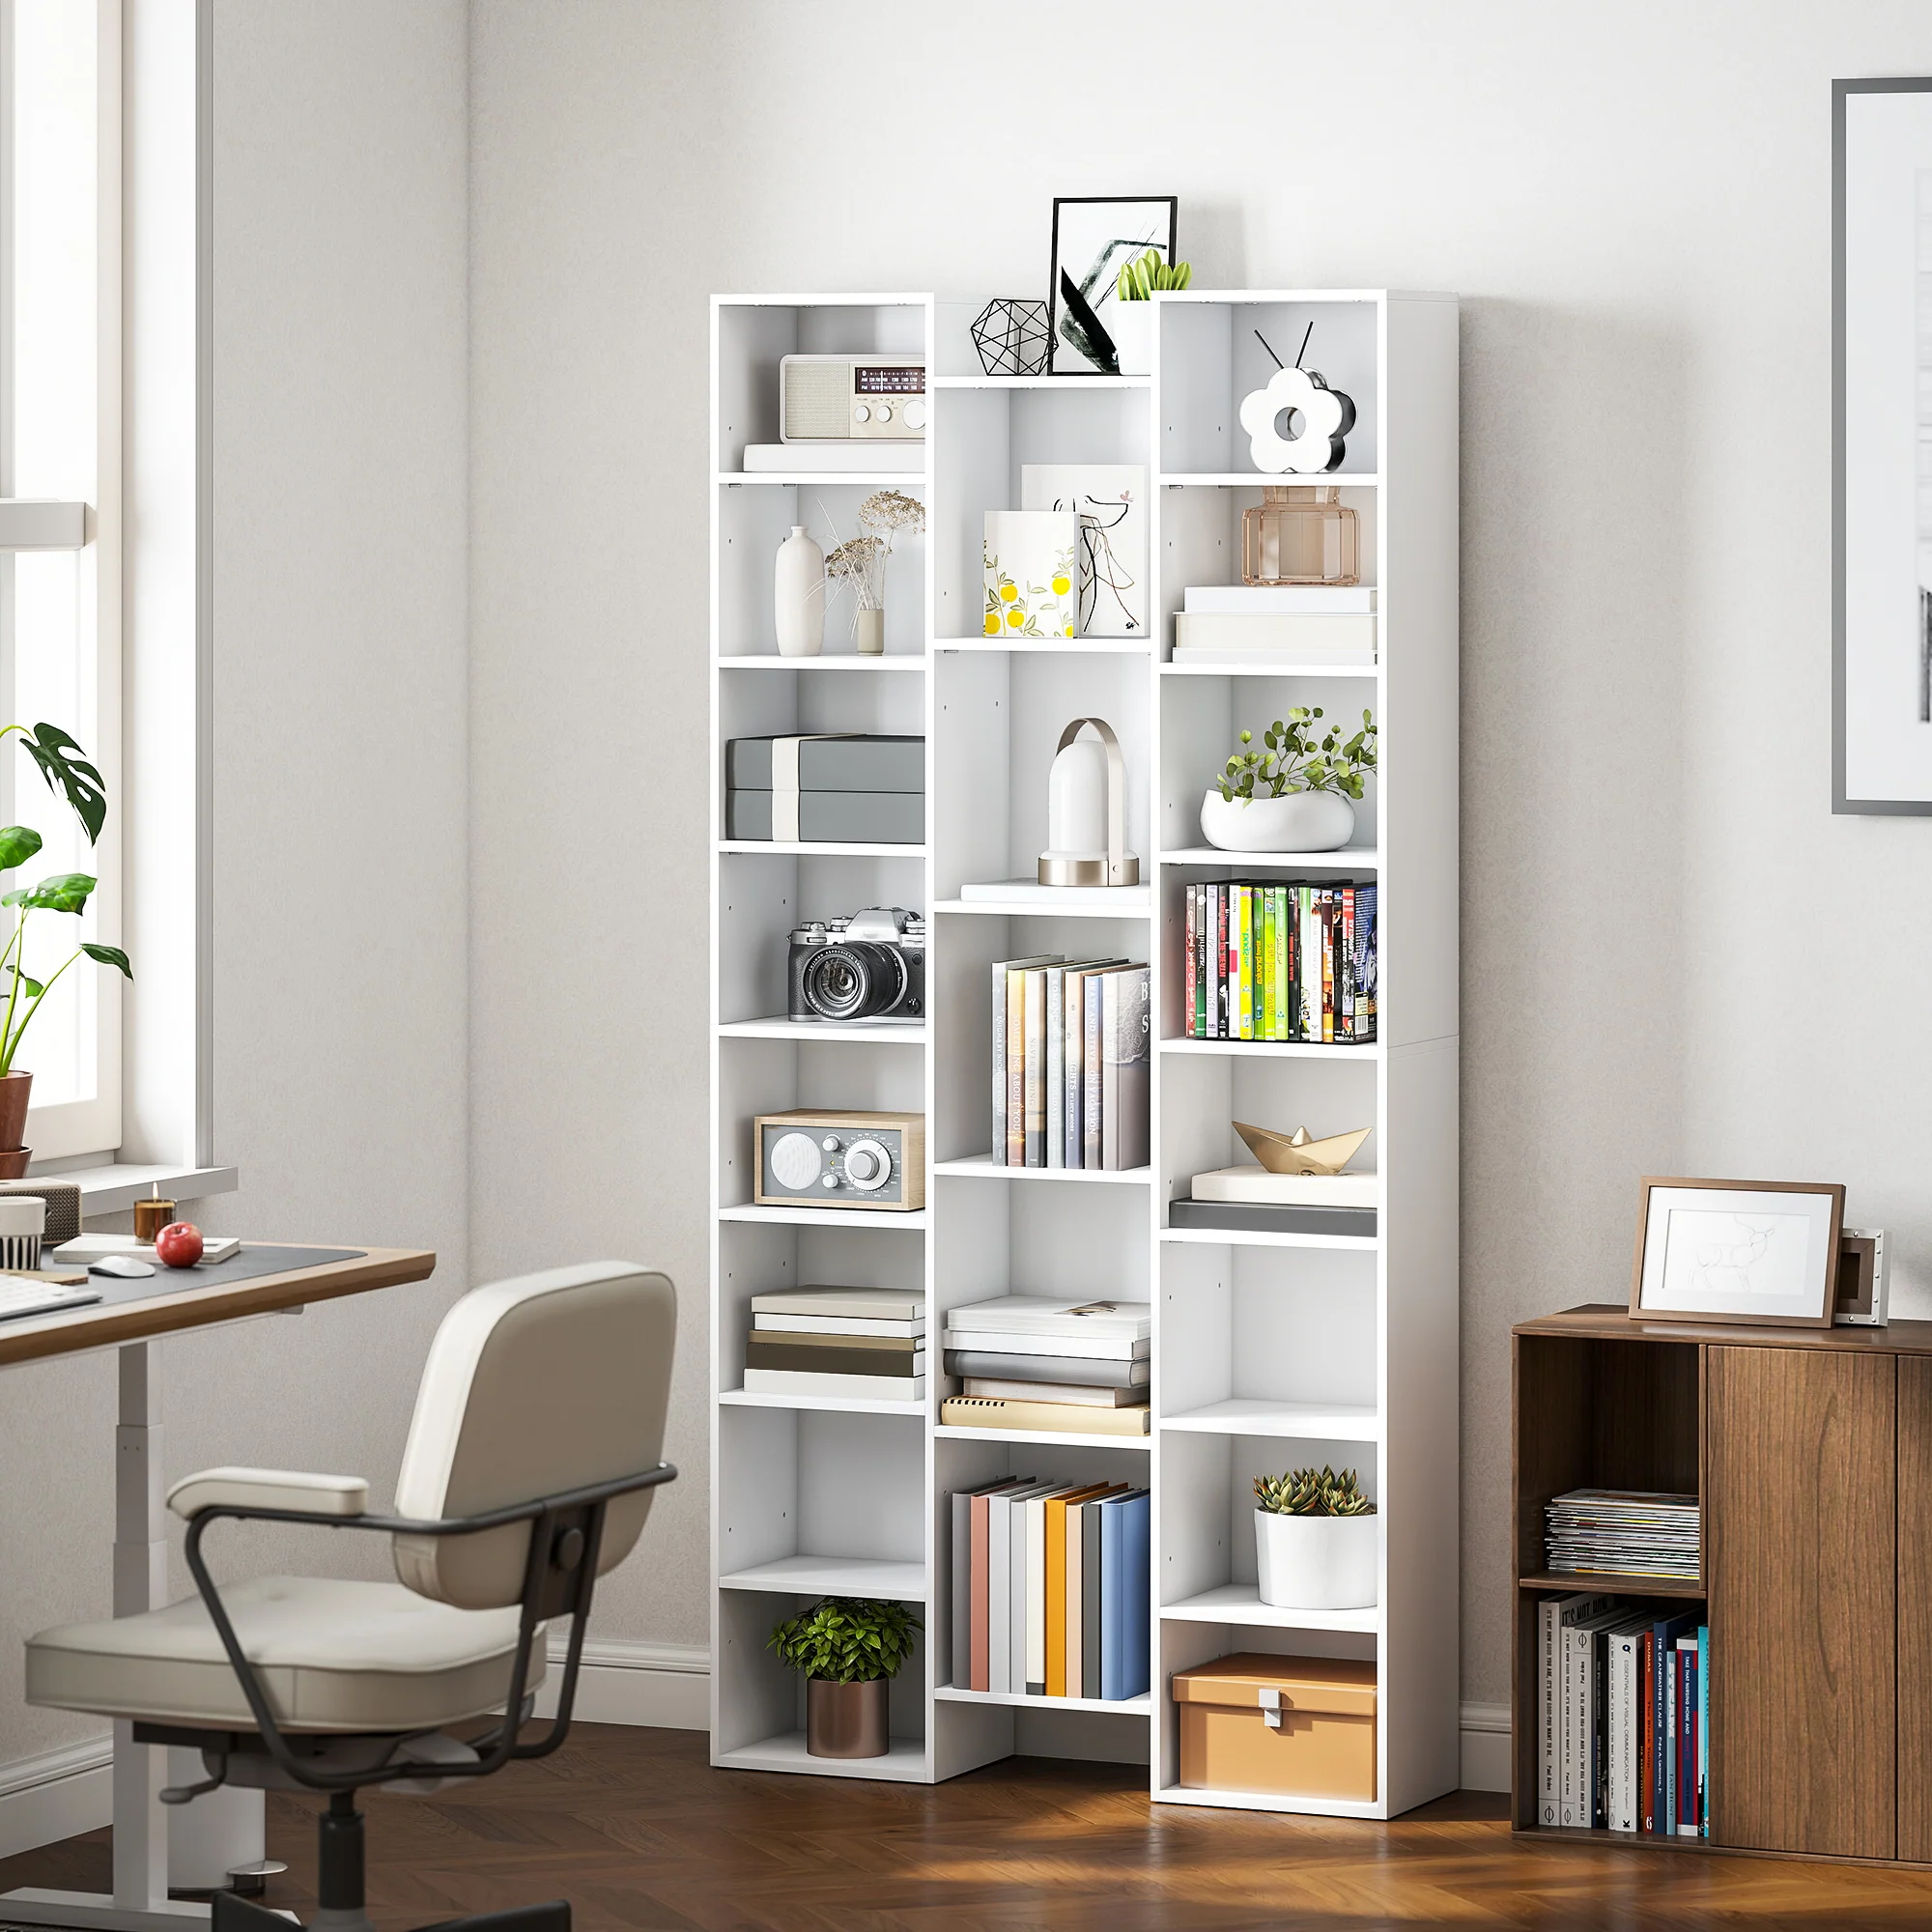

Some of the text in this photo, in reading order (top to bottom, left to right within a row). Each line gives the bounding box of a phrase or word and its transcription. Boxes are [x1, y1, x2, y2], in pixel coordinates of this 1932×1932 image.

[1089, 1070, 1095, 1084] ON
[1577, 1601, 1590, 1620] NOT
[1624, 1697, 1630, 1706] OF
